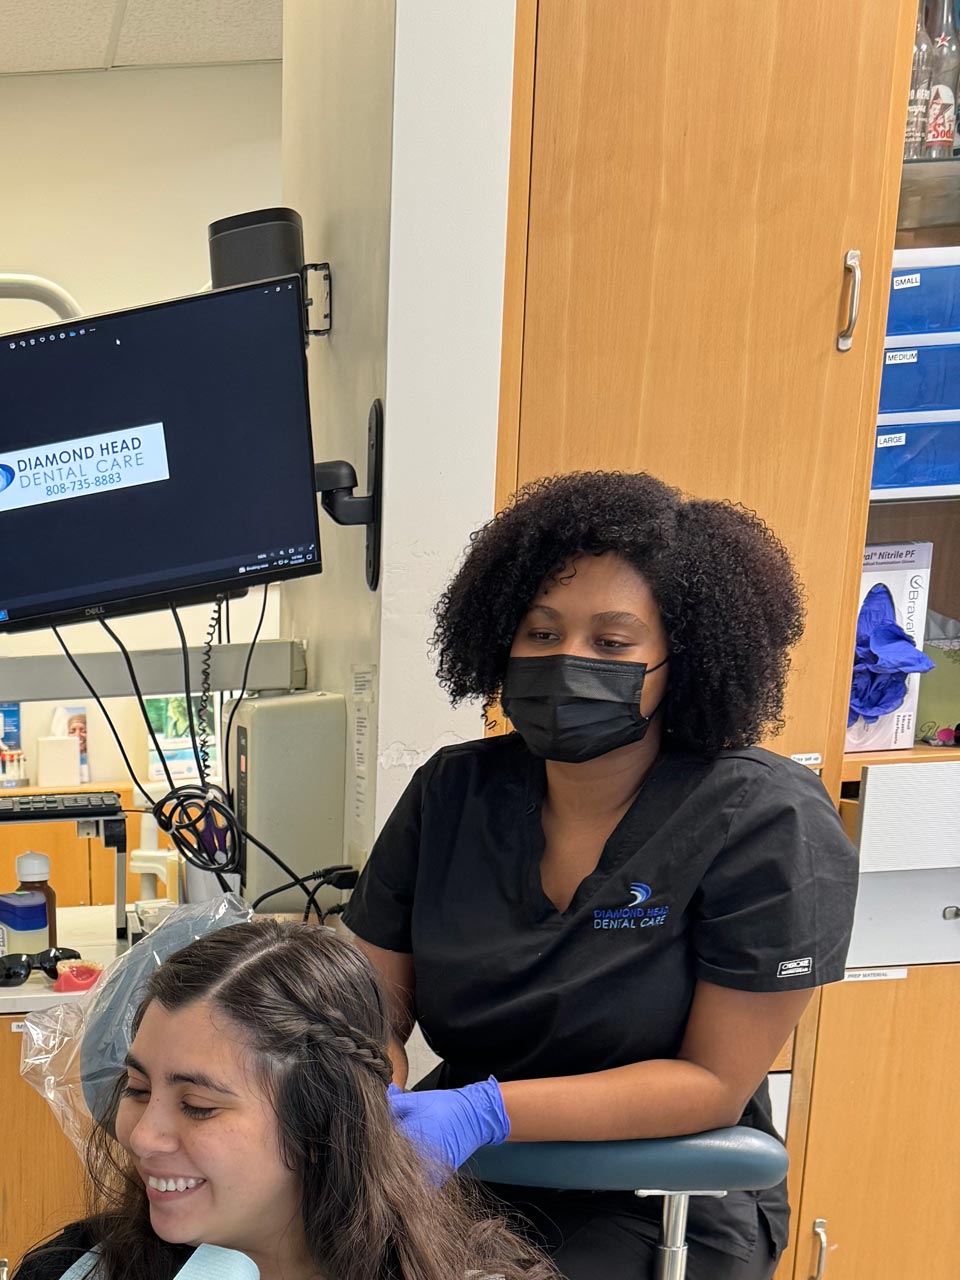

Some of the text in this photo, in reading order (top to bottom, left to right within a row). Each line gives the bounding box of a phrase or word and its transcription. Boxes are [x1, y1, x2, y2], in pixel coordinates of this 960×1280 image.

[895, 276, 920, 287] SMALL
[887, 352, 917, 361] MEDIUM
[879, 435, 904, 445] LARGE
[17, 437, 142, 473] DIAMOND HEAD
[19, 452, 145, 489] DENTAL CARE
[46, 472, 122, 497] 808-735-8883
[878, 550, 904, 560] Nitrile
[904, 549, 916, 558] PF
[85, 605, 105, 616] DELL
[593, 906, 669, 919] DIAMOND HEAD
[594, 915, 666, 929] DENTAL CARE
